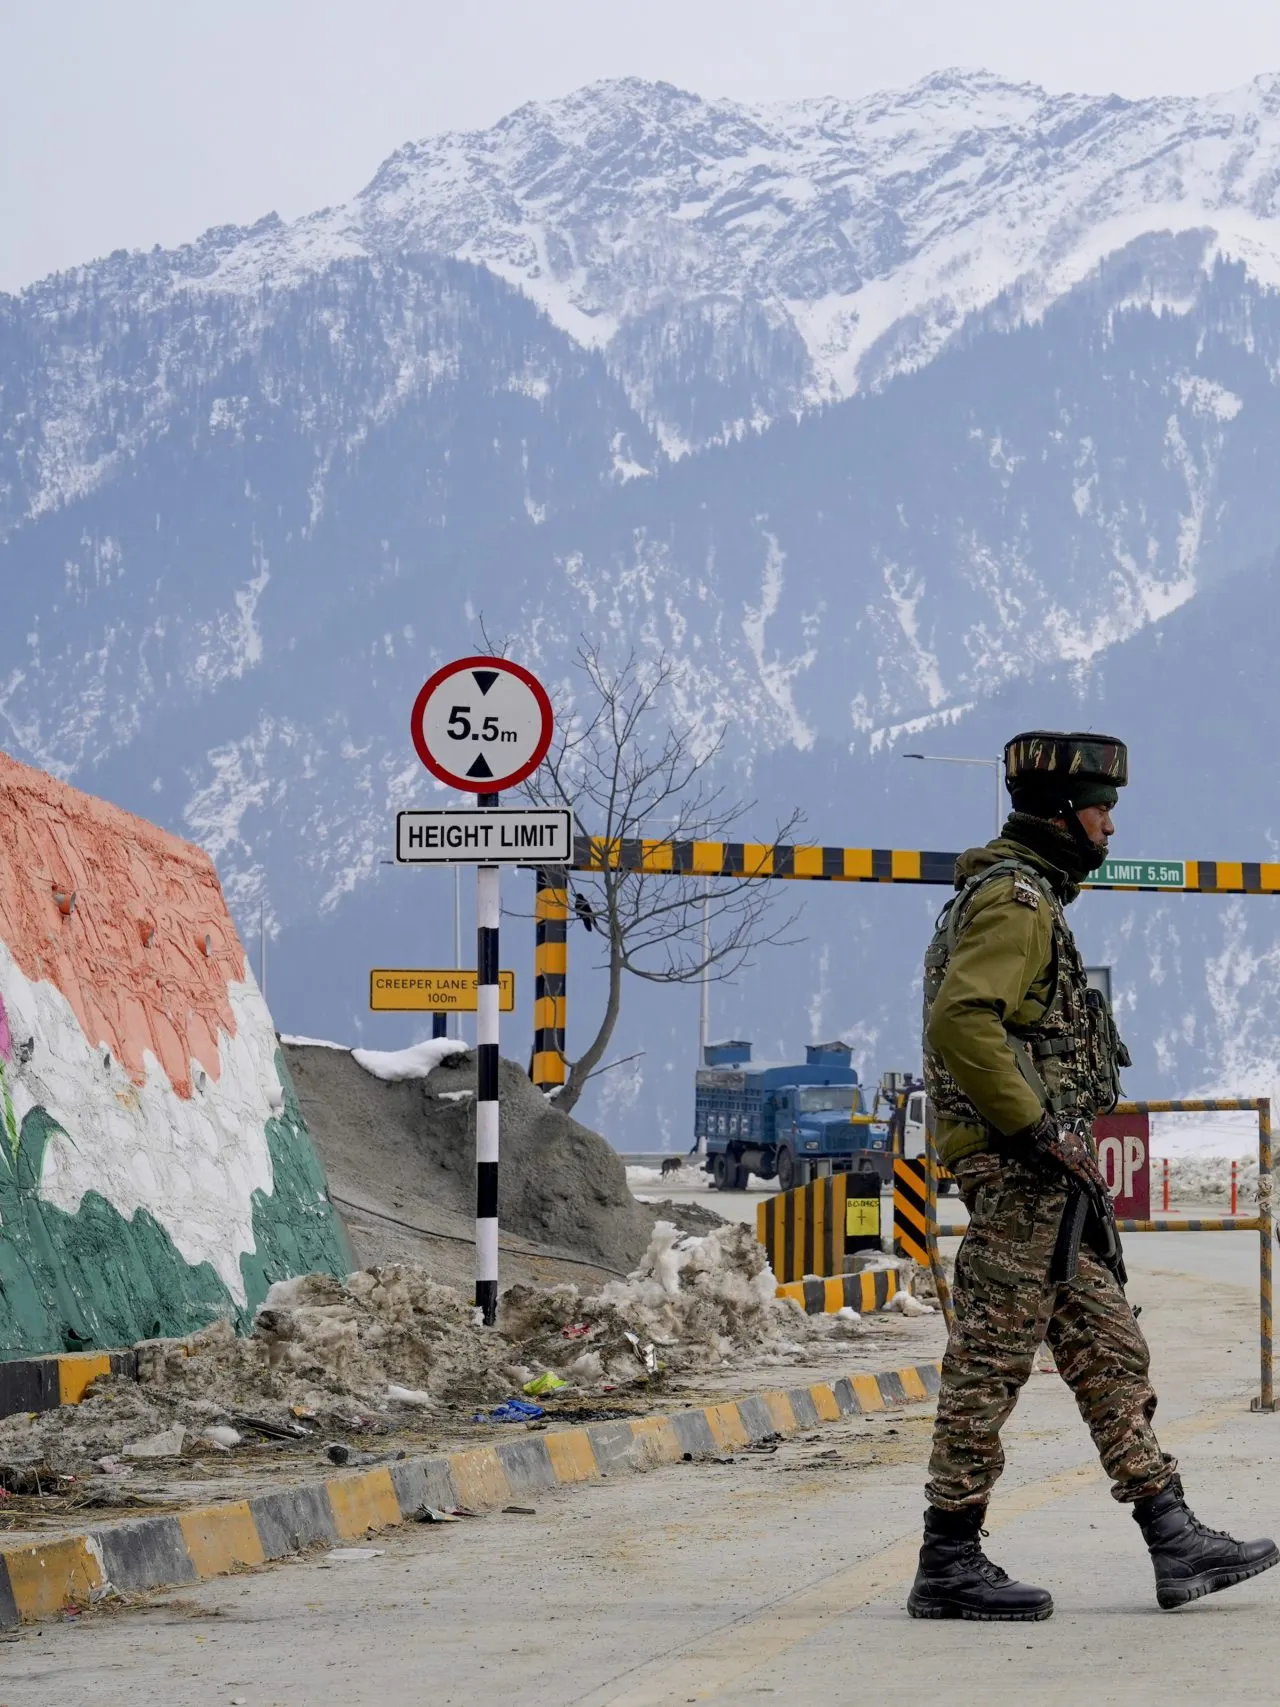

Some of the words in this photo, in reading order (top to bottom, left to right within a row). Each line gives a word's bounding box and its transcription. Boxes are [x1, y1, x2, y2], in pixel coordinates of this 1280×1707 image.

[446, 705, 518, 743] 5.5m
[408, 825, 494, 849] HEIGHT
[500, 824, 559, 848] LIMIT
[1105, 865, 1143, 881] LIMIT
[1147, 866, 1180, 882] 5.5m
[375, 978, 433, 990] CREEPER
[436, 979, 469, 990] LANE
[427, 993, 457, 1004] 100m
[1093, 1136, 1146, 1201] OP
